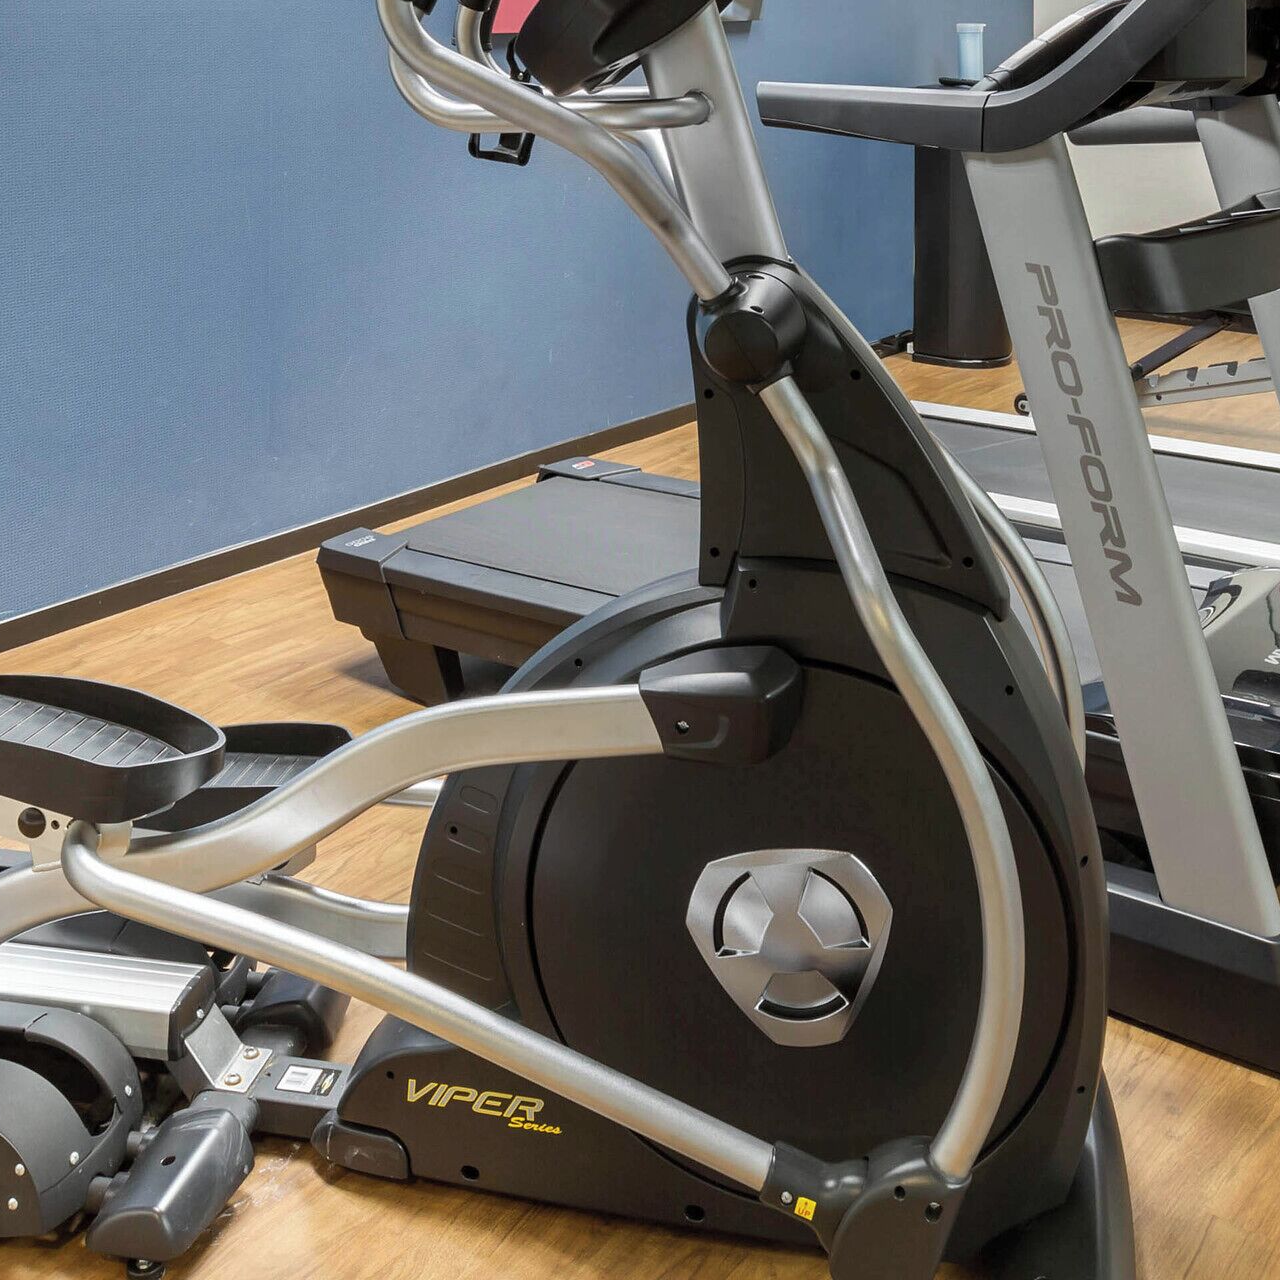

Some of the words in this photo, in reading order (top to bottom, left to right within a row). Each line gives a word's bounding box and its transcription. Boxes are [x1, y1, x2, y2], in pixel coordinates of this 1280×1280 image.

[1024, 262, 1143, 607] PRO-FORM
[406, 1078, 545, 1122] VIPER
[507, 1116, 563, 1135] Series
[797, 1206, 811, 1217] UP
